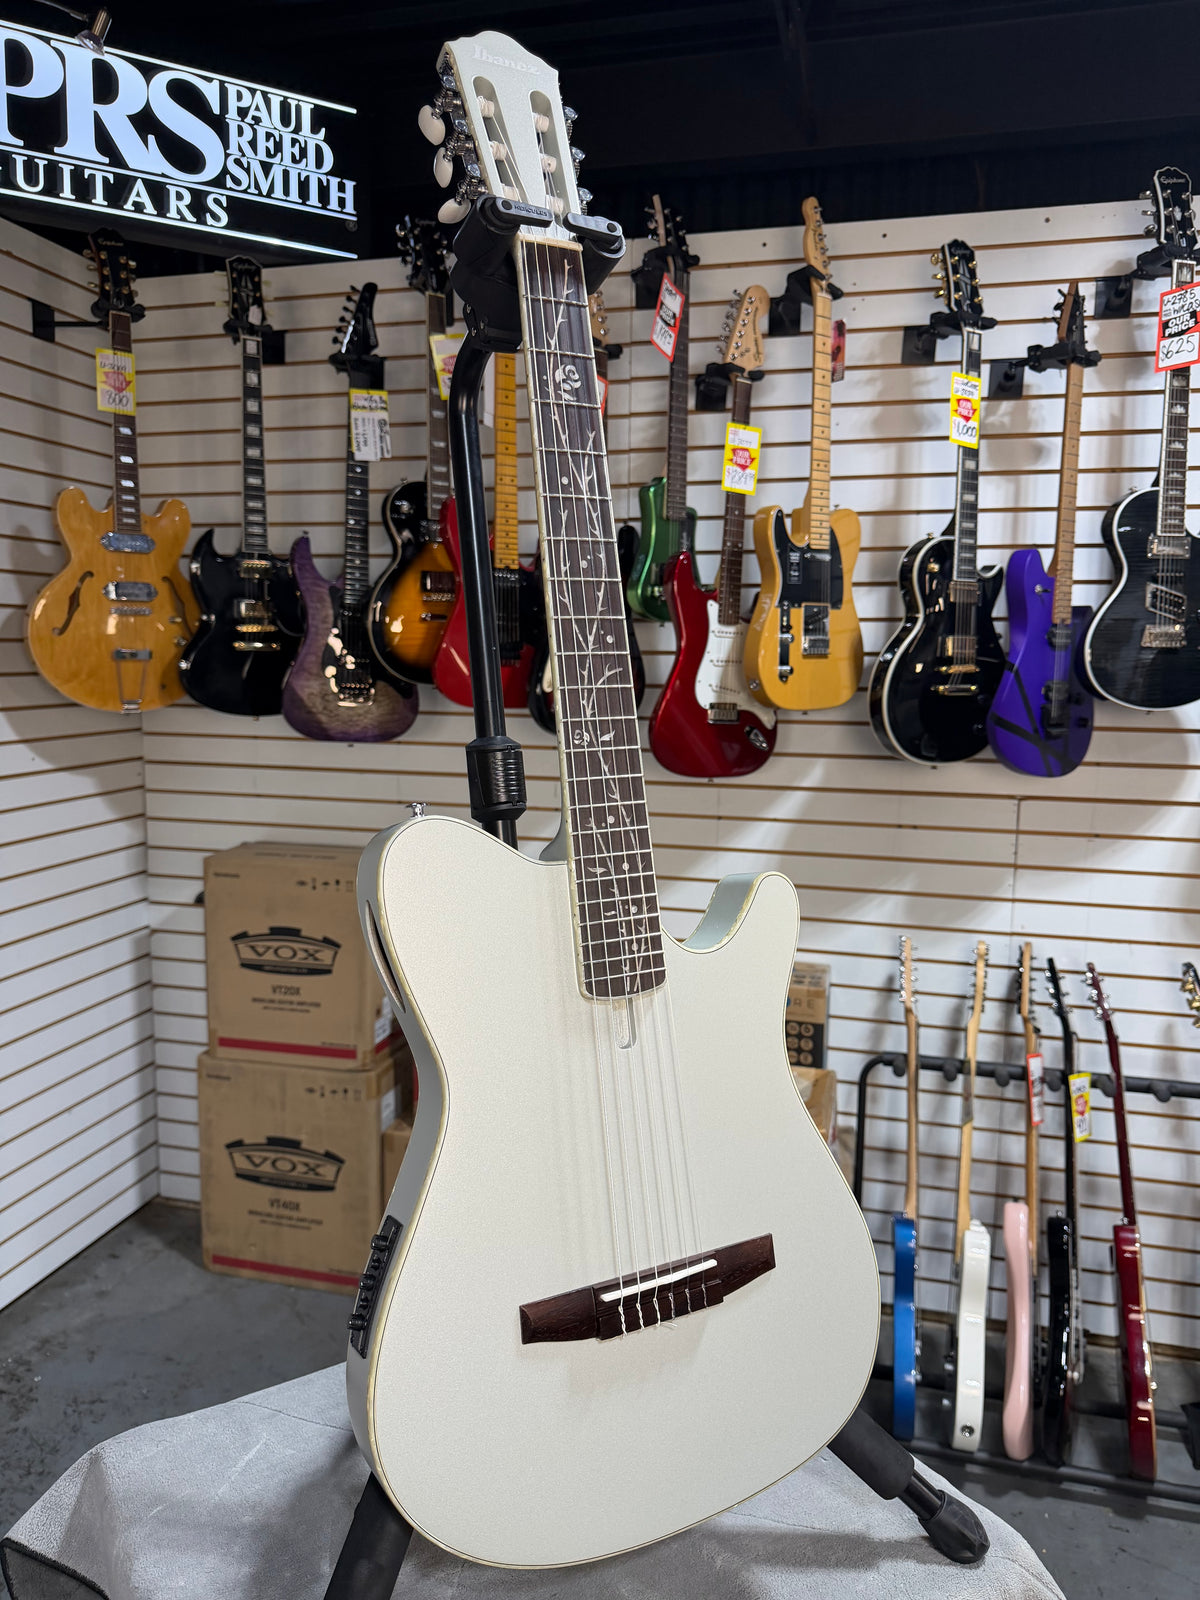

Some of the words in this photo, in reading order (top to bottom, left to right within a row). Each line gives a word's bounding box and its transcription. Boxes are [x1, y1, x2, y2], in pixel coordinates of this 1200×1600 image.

[472, 44, 540, 75] Ibanez
[0, 26, 225, 183] PRS
[225, 83, 326, 140] PAUL
[225, 119, 334, 174] REED
[0, 154, 229, 228] UITARS
[226, 153, 357, 215] SMITH
[1165, 319, 1196, 338] PRICE
[1168, 313, 1191, 328] OUR
[1161, 334, 1196, 362] $625
[245, 944, 325, 962] VOX
[242, 1153, 327, 1178] VOX
